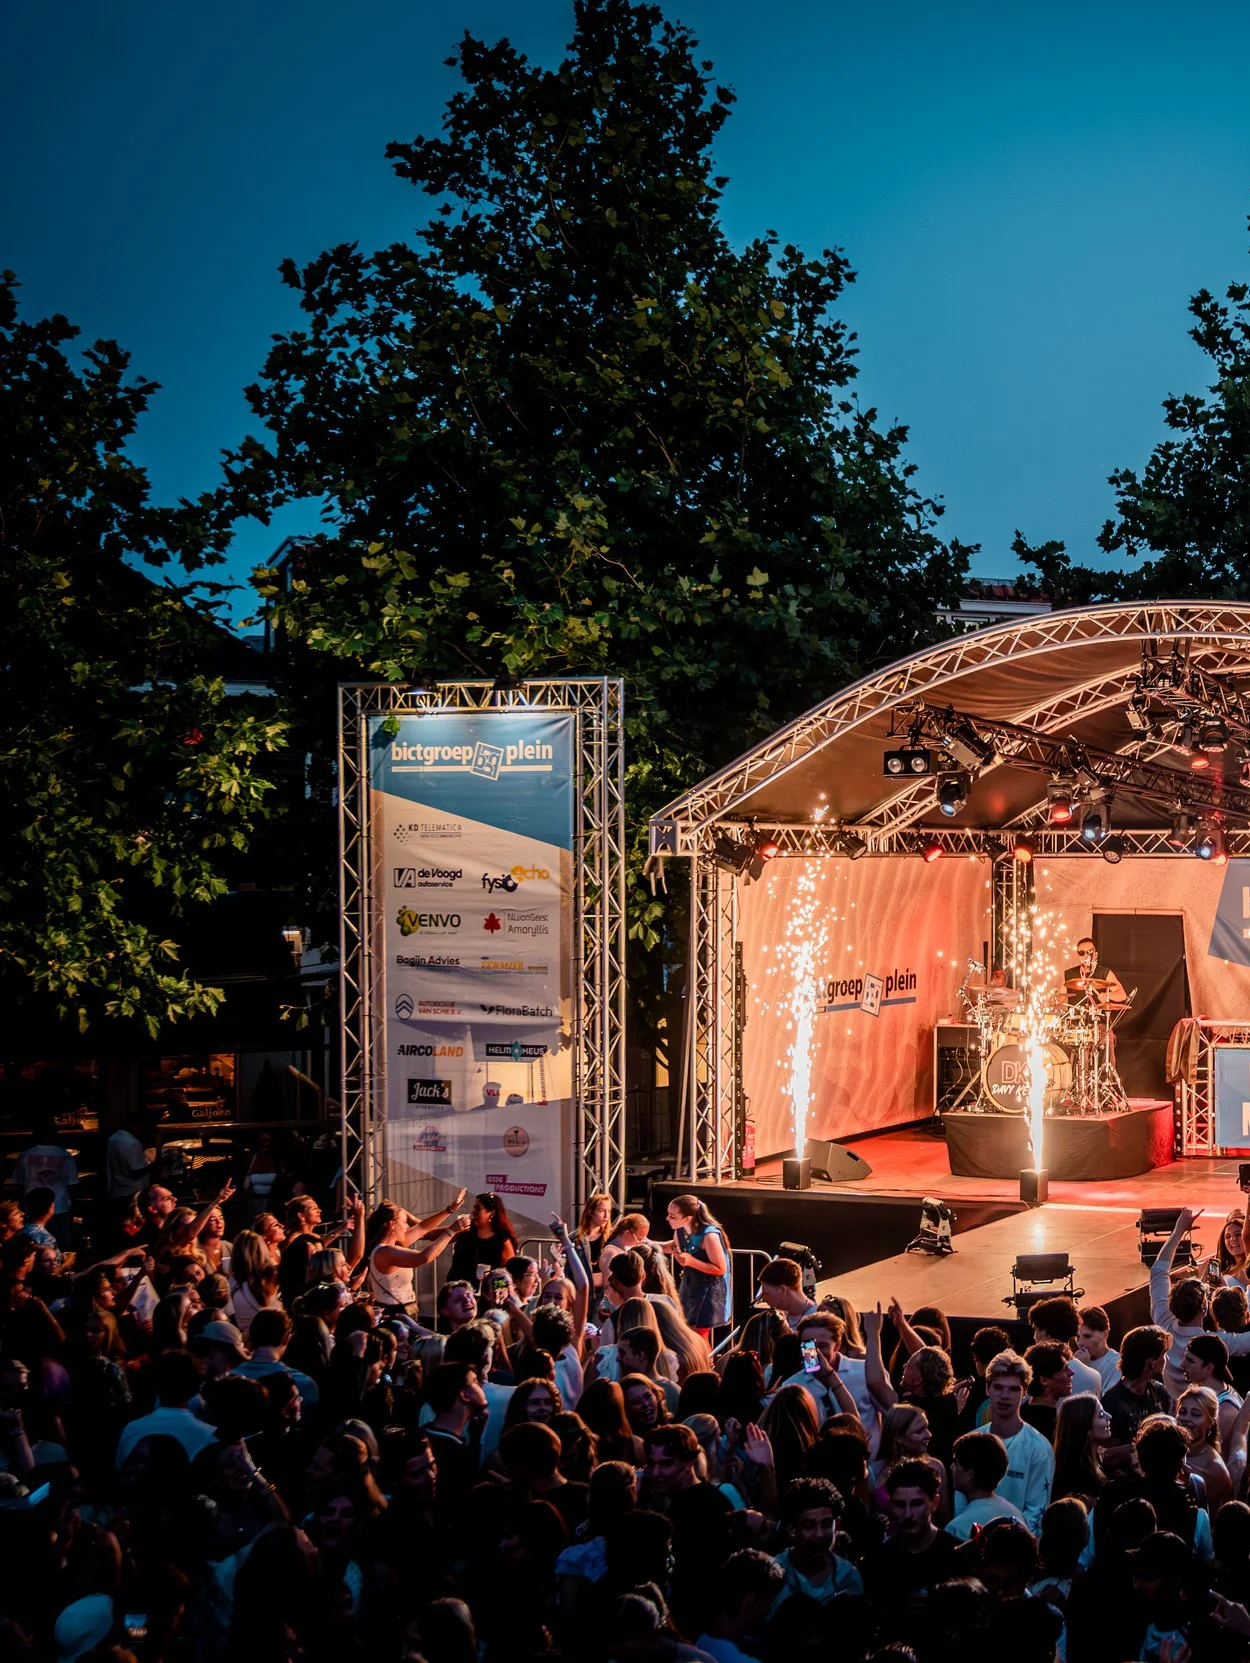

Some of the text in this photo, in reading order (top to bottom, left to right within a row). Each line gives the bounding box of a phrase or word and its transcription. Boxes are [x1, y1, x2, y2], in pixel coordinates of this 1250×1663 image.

[392, 742, 473, 766] bictgroep
[506, 739, 553, 764] plein
[408, 823, 463, 832] KD TELEMATICA
[408, 914, 462, 928] VENVO
[508, 925, 549, 938] Amaryllis
[396, 955, 460, 967] Bagijn Advies
[886, 968, 917, 998] plein
[495, 1004, 552, 1017] FloraBatch
[398, 1044, 464, 1057] AIRCOLAND
[488, 1046, 545, 1055] HELM HEUS
[411, 1082, 449, 1100] Jack's
[992, 1083, 1015, 1095] DAVY
[495, 1184, 546, 1194] PRODUCTIONS
